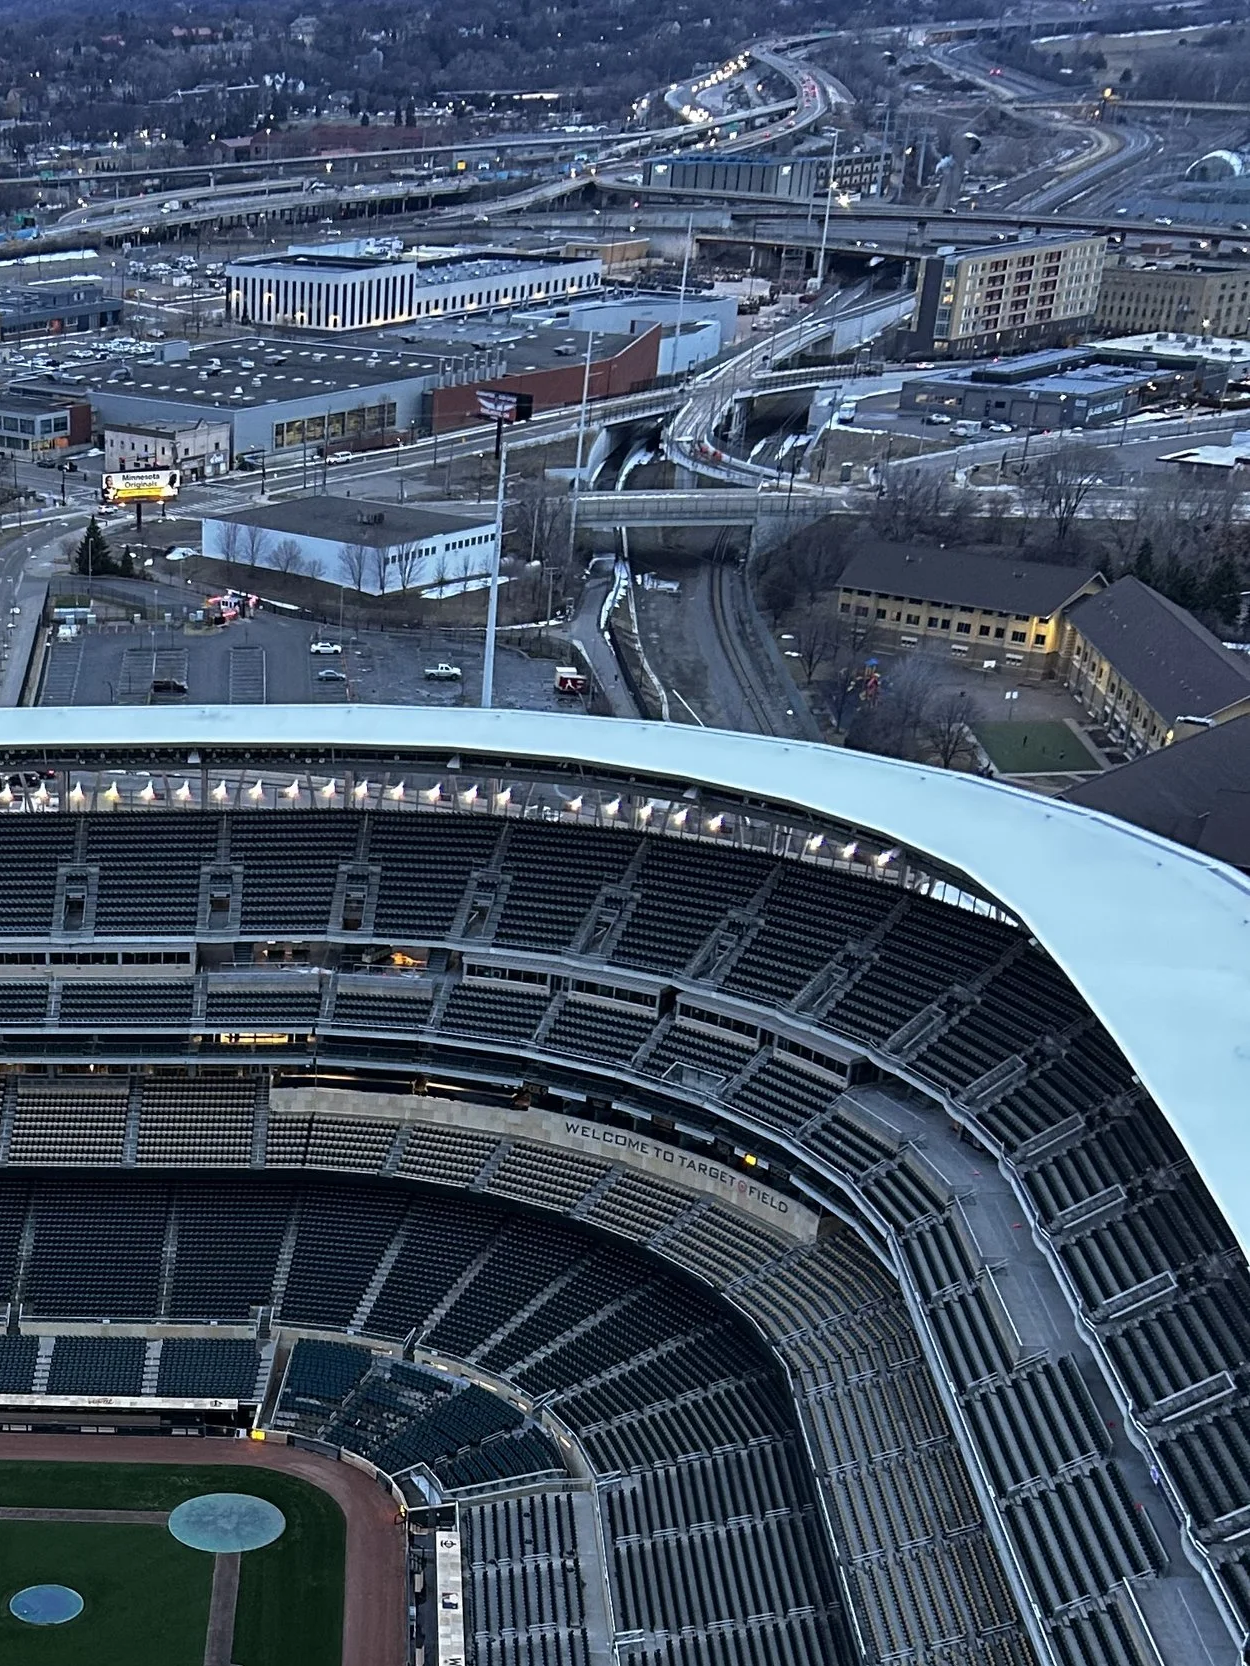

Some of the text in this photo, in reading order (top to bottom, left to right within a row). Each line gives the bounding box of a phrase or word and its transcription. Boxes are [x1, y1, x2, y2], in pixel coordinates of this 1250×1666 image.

[121, 473, 160, 481] Minnesota
[124, 481, 158, 489] Originals
[565, 1121, 650, 1154] WELCOME
[654, 1146, 675, 1163] TO
[679, 1156, 737, 1187] TARGET
[748, 1184, 789, 1214] FIELD
